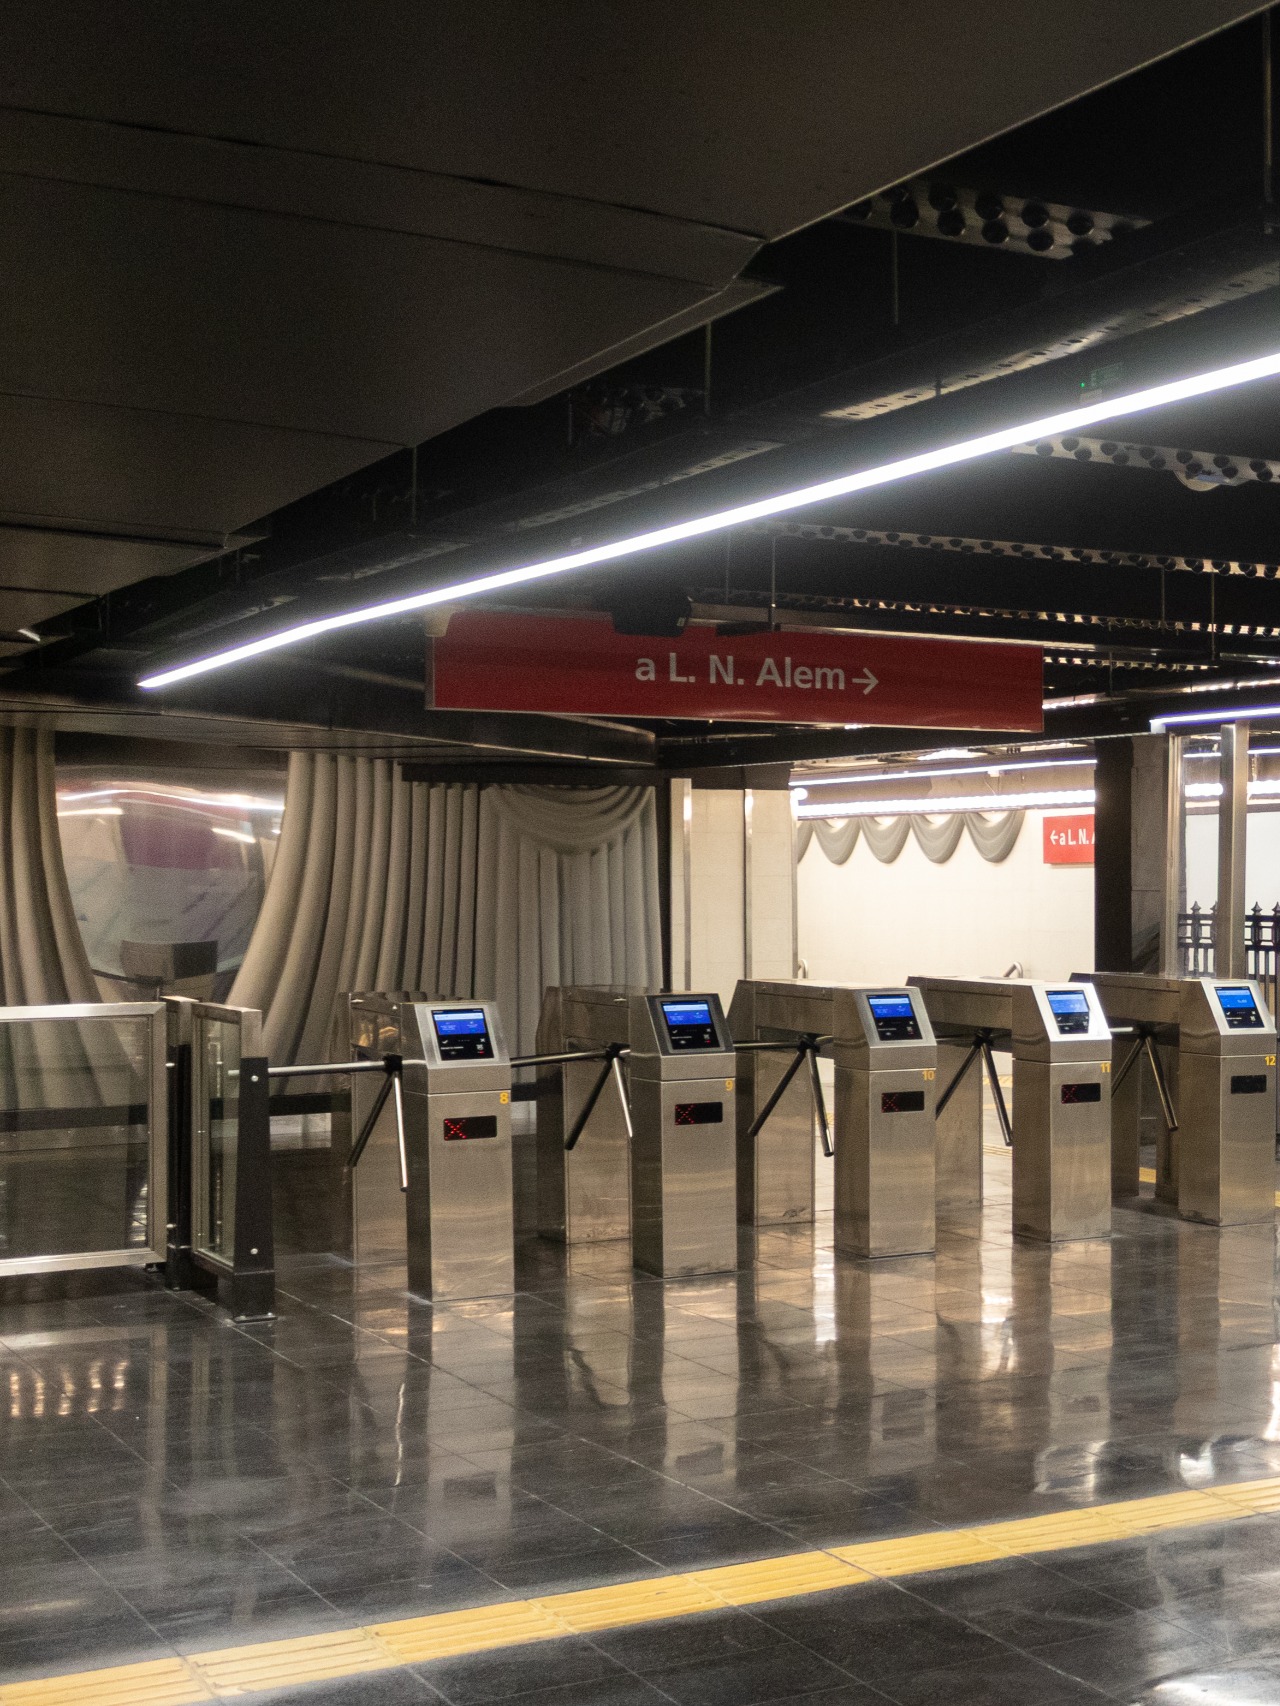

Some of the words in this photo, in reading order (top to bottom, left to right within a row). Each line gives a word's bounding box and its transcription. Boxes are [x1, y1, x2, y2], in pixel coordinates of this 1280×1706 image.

[635, 657, 656, 681] a
[669, 652, 696, 683] L.
[709, 654, 745, 685] N.
[755, 656, 846, 690] Alem
[1059, 832, 1066, 845] a
[1067, 828, 1077, 845] L.
[1078, 828, 1090, 845] N.
[1264, 1055, 1276, 1066] 12
[1101, 1062, 1111, 1073] 11
[922, 1070, 935, 1081] 10
[725, 1079, 734, 1091] 9
[499, 1092, 509, 1105] 8
